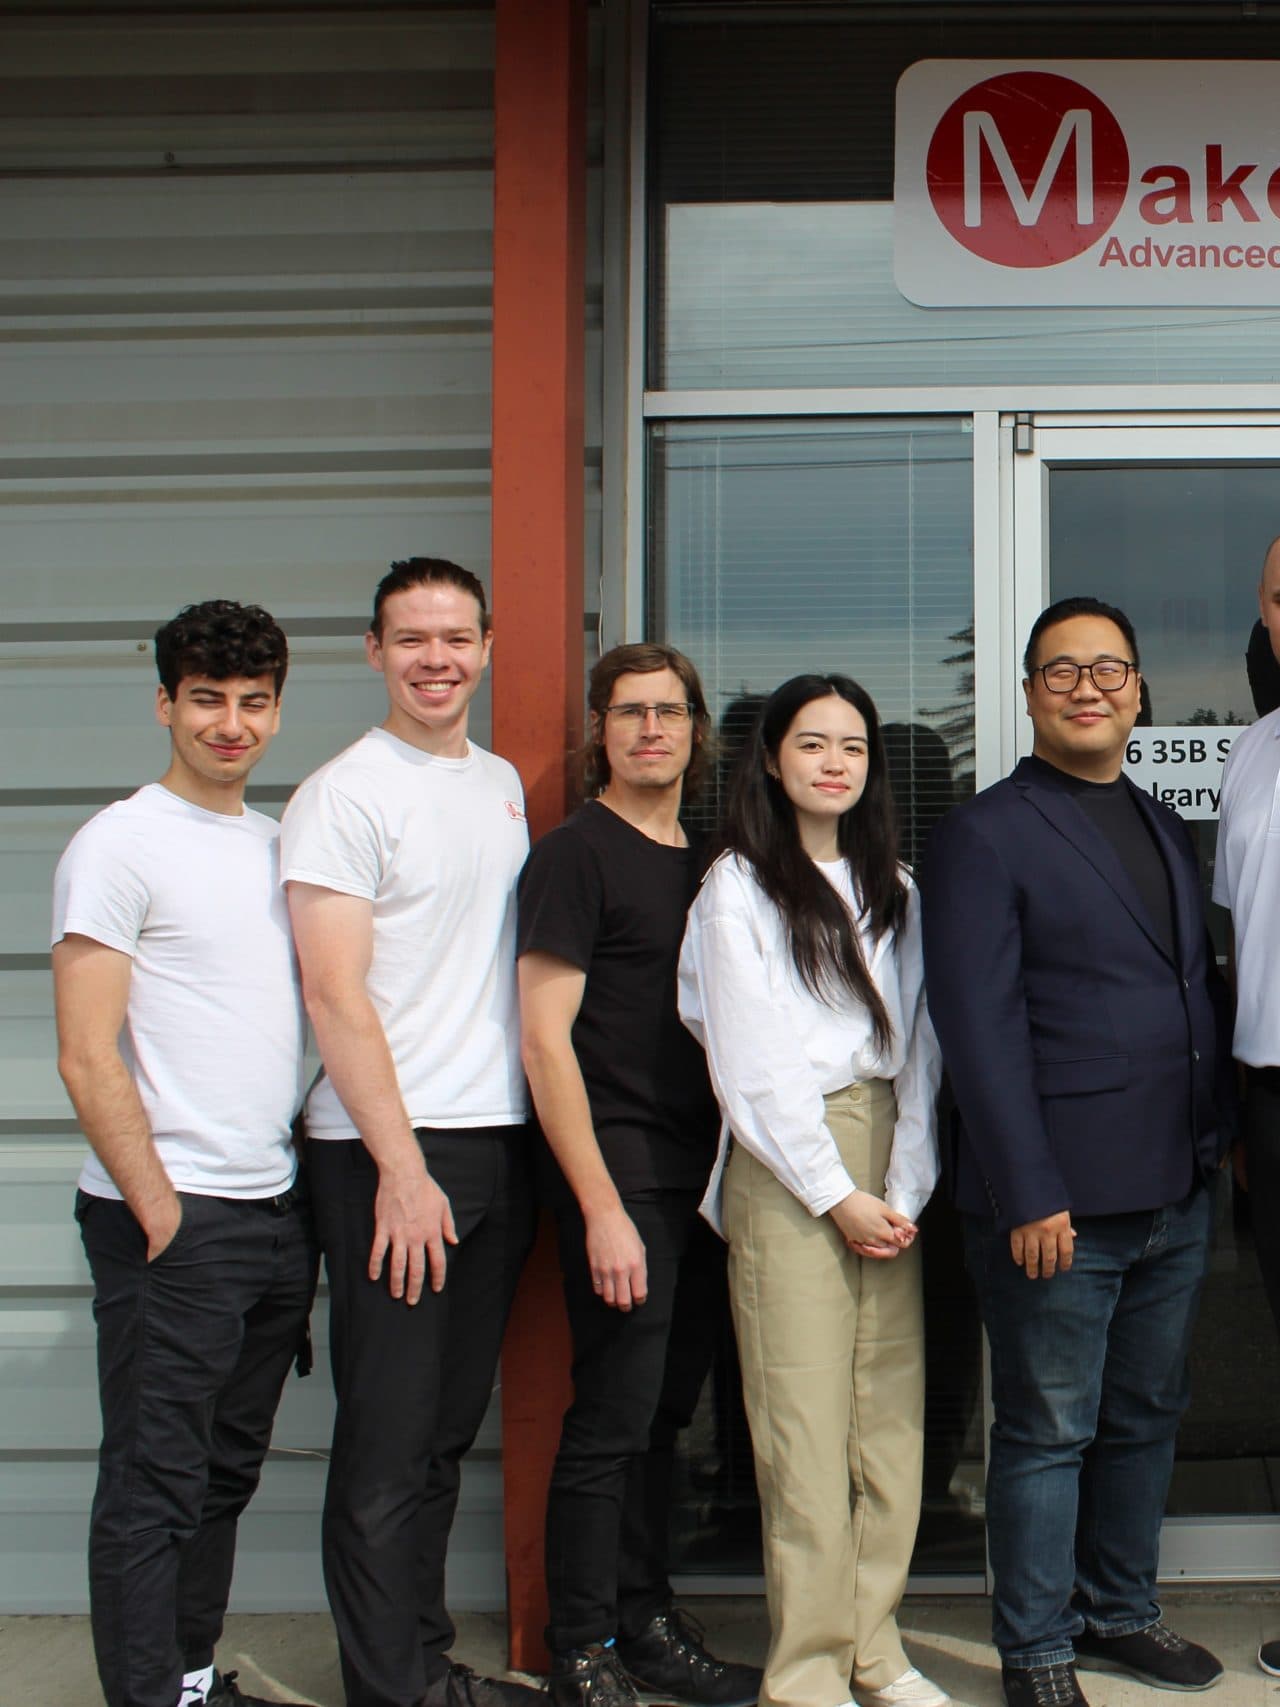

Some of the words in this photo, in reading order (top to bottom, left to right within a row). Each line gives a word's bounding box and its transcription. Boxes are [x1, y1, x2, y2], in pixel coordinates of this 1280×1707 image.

[1126, 740, 1143, 764] 6
[1152, 739, 1207, 764] 35B
[1216, 738, 1231, 763] S
[1152, 782, 1221, 812] lgary
